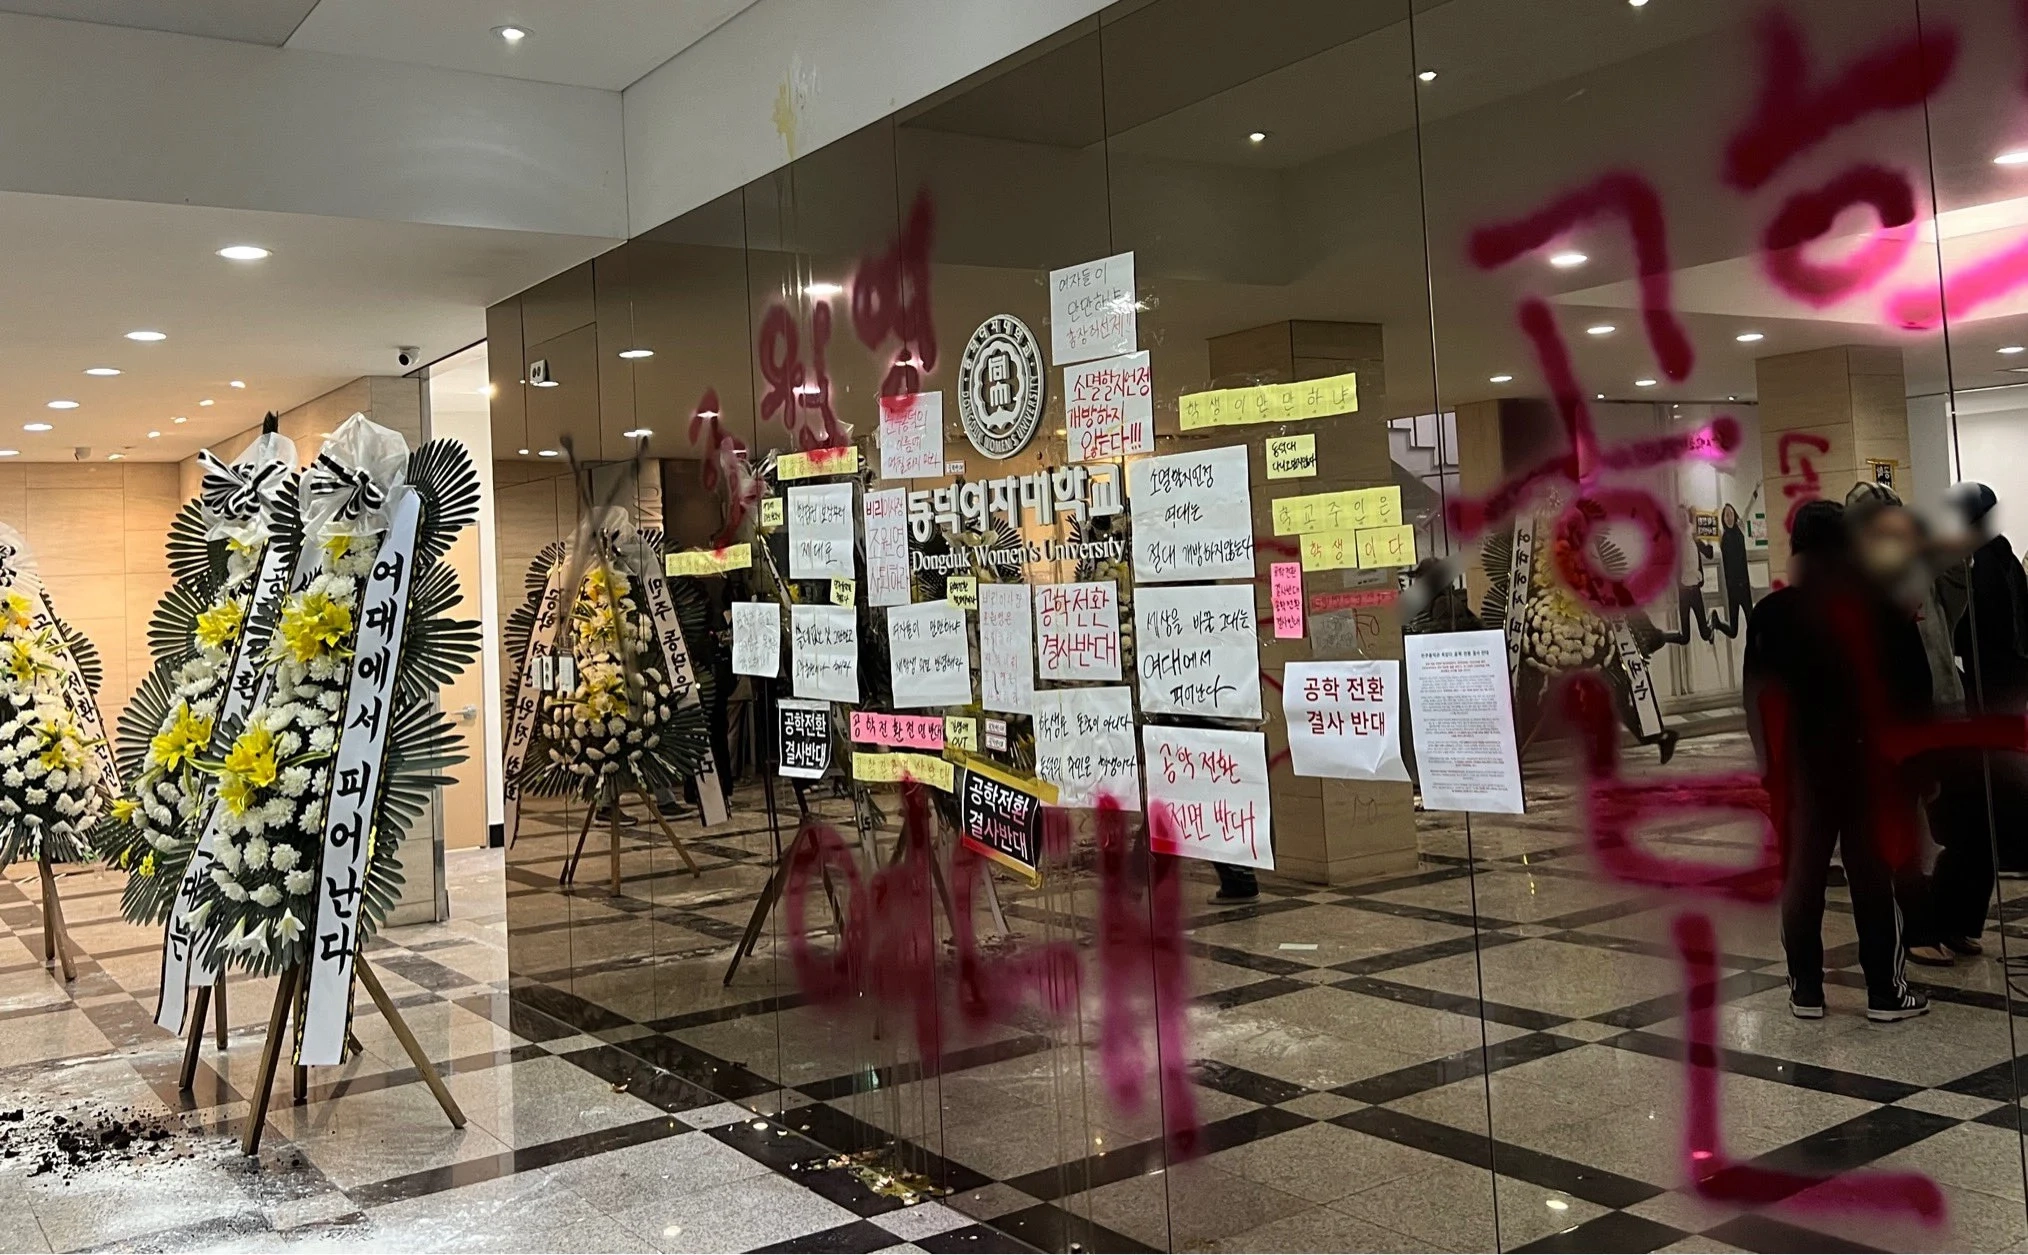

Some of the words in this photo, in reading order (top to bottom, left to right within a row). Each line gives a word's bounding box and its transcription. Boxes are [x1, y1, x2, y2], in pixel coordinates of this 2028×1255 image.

[1058, 262, 1107, 291] 여자들이
[1072, 367, 1150, 402] 소멸할지언정
[1067, 400, 1125, 428] 개방하지
[1081, 422, 1142, 460] 않는다!!!
[907, 464, 1124, 543] 동덕여자대학교
[868, 525, 906, 560] 조원영
[912, 550, 971, 575] Dongduk
[971, 542, 1041, 568] Women's
[1043, 535, 1126, 565] University
[1147, 541, 1176, 573] 절대
[1041, 586, 1110, 627] 공학전환
[1147, 608, 1183, 638] 세상을
[1192, 610, 1215, 634] 바꿀
[1219, 609, 1250, 631] 그대는
[347, 552, 405, 745] 여대에서
[1042, 631, 1117, 669] 결사반대
[1143, 648, 1211, 680] 여대에서
[1170, 674, 1237, 708] 피어난다
[1303, 677, 1340, 702] 공학
[1346, 677, 1385, 702] 전환
[784, 711, 826, 738] 공학전환
[1308, 711, 1345, 736] 결사
[1351, 711, 1386, 737] 반대
[785, 741, 826, 768] 결사반대
[952, 736, 968, 748] OUT
[1159, 743, 1195, 784] 공학
[1199, 749, 1241, 784] 전환
[969, 776, 1029, 826] 공학전환
[969, 810, 1028, 861] 결사반대
[1165, 802, 1211, 841] 전면
[1213, 798, 1258, 860] 반대
[319, 760, 372, 976] 피어난다
